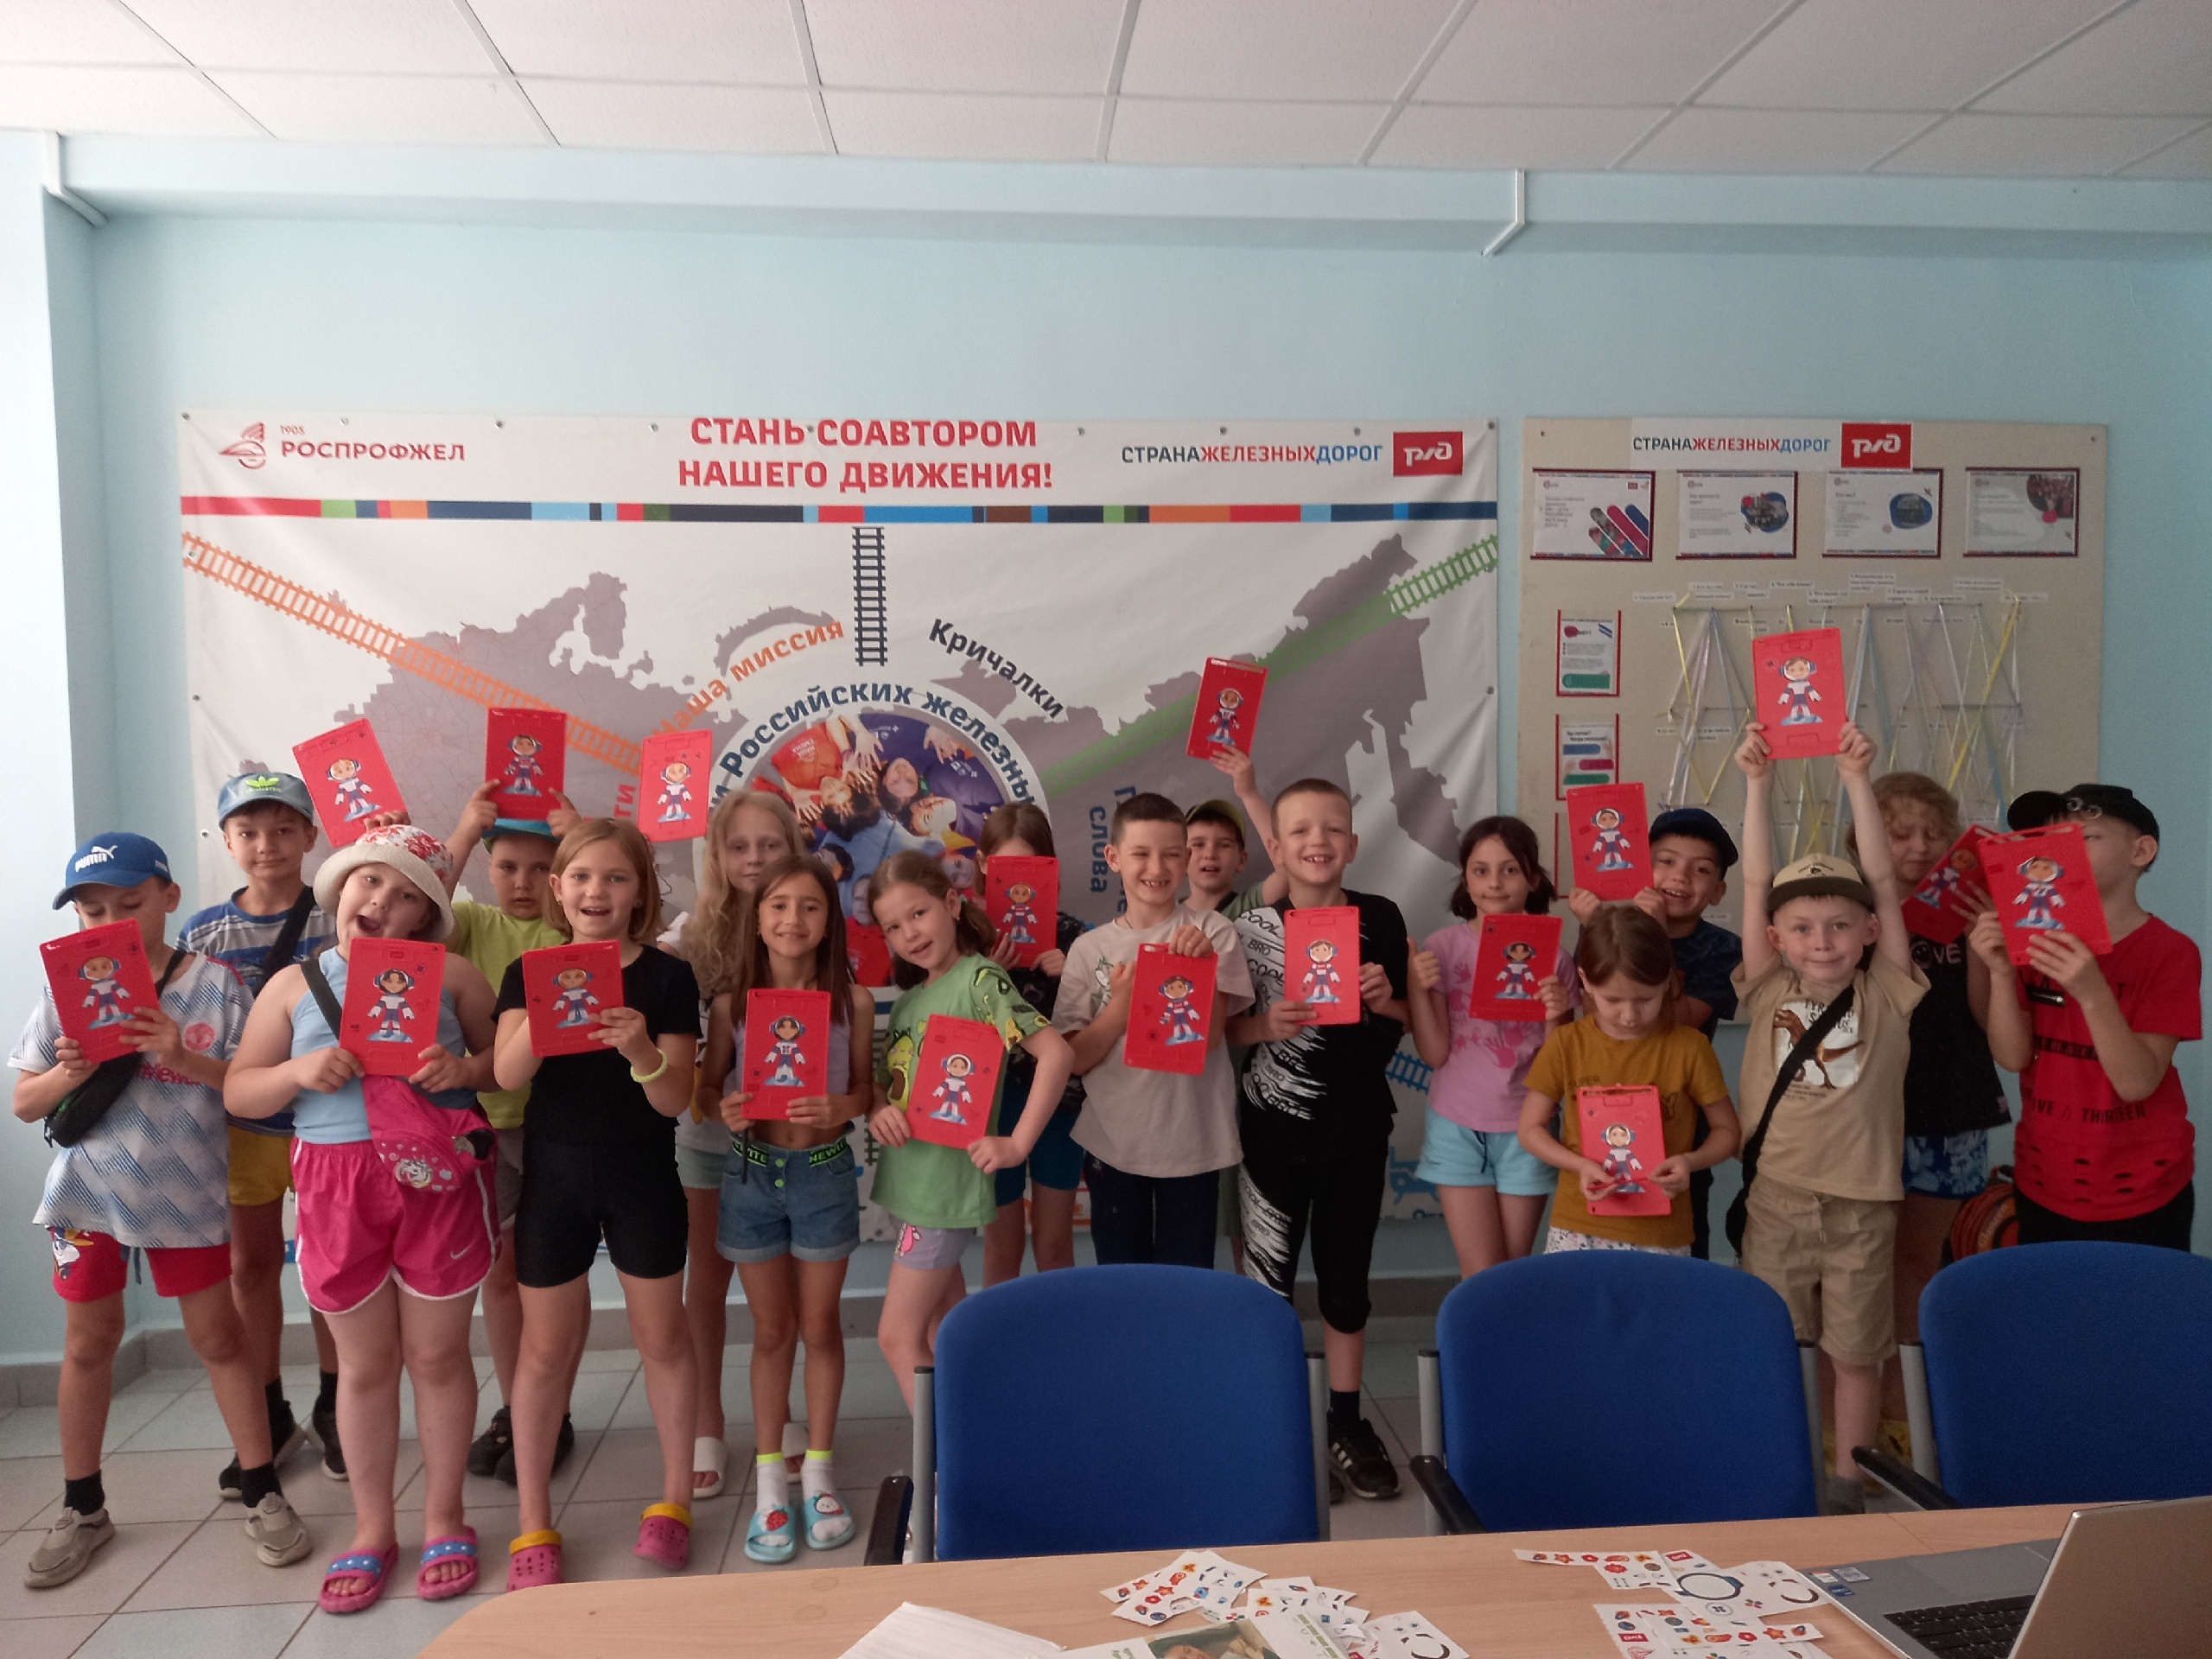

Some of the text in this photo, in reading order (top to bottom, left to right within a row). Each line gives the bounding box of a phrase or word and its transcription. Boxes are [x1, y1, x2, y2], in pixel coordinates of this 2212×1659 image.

[281, 440, 466, 461] РОСПРОФЖЕЛ
[691, 417, 1037, 448] СТАНЬ СОАВТОРОМ
[678, 460, 1053, 493] НАШЕГО ДВИЖЕНИЯ!
[730, 620, 845, 682] миссия
[930, 618, 1065, 719] Кричалки
[719, 682, 1036, 805] Российских железны
[1089, 805, 1109, 893] слова
